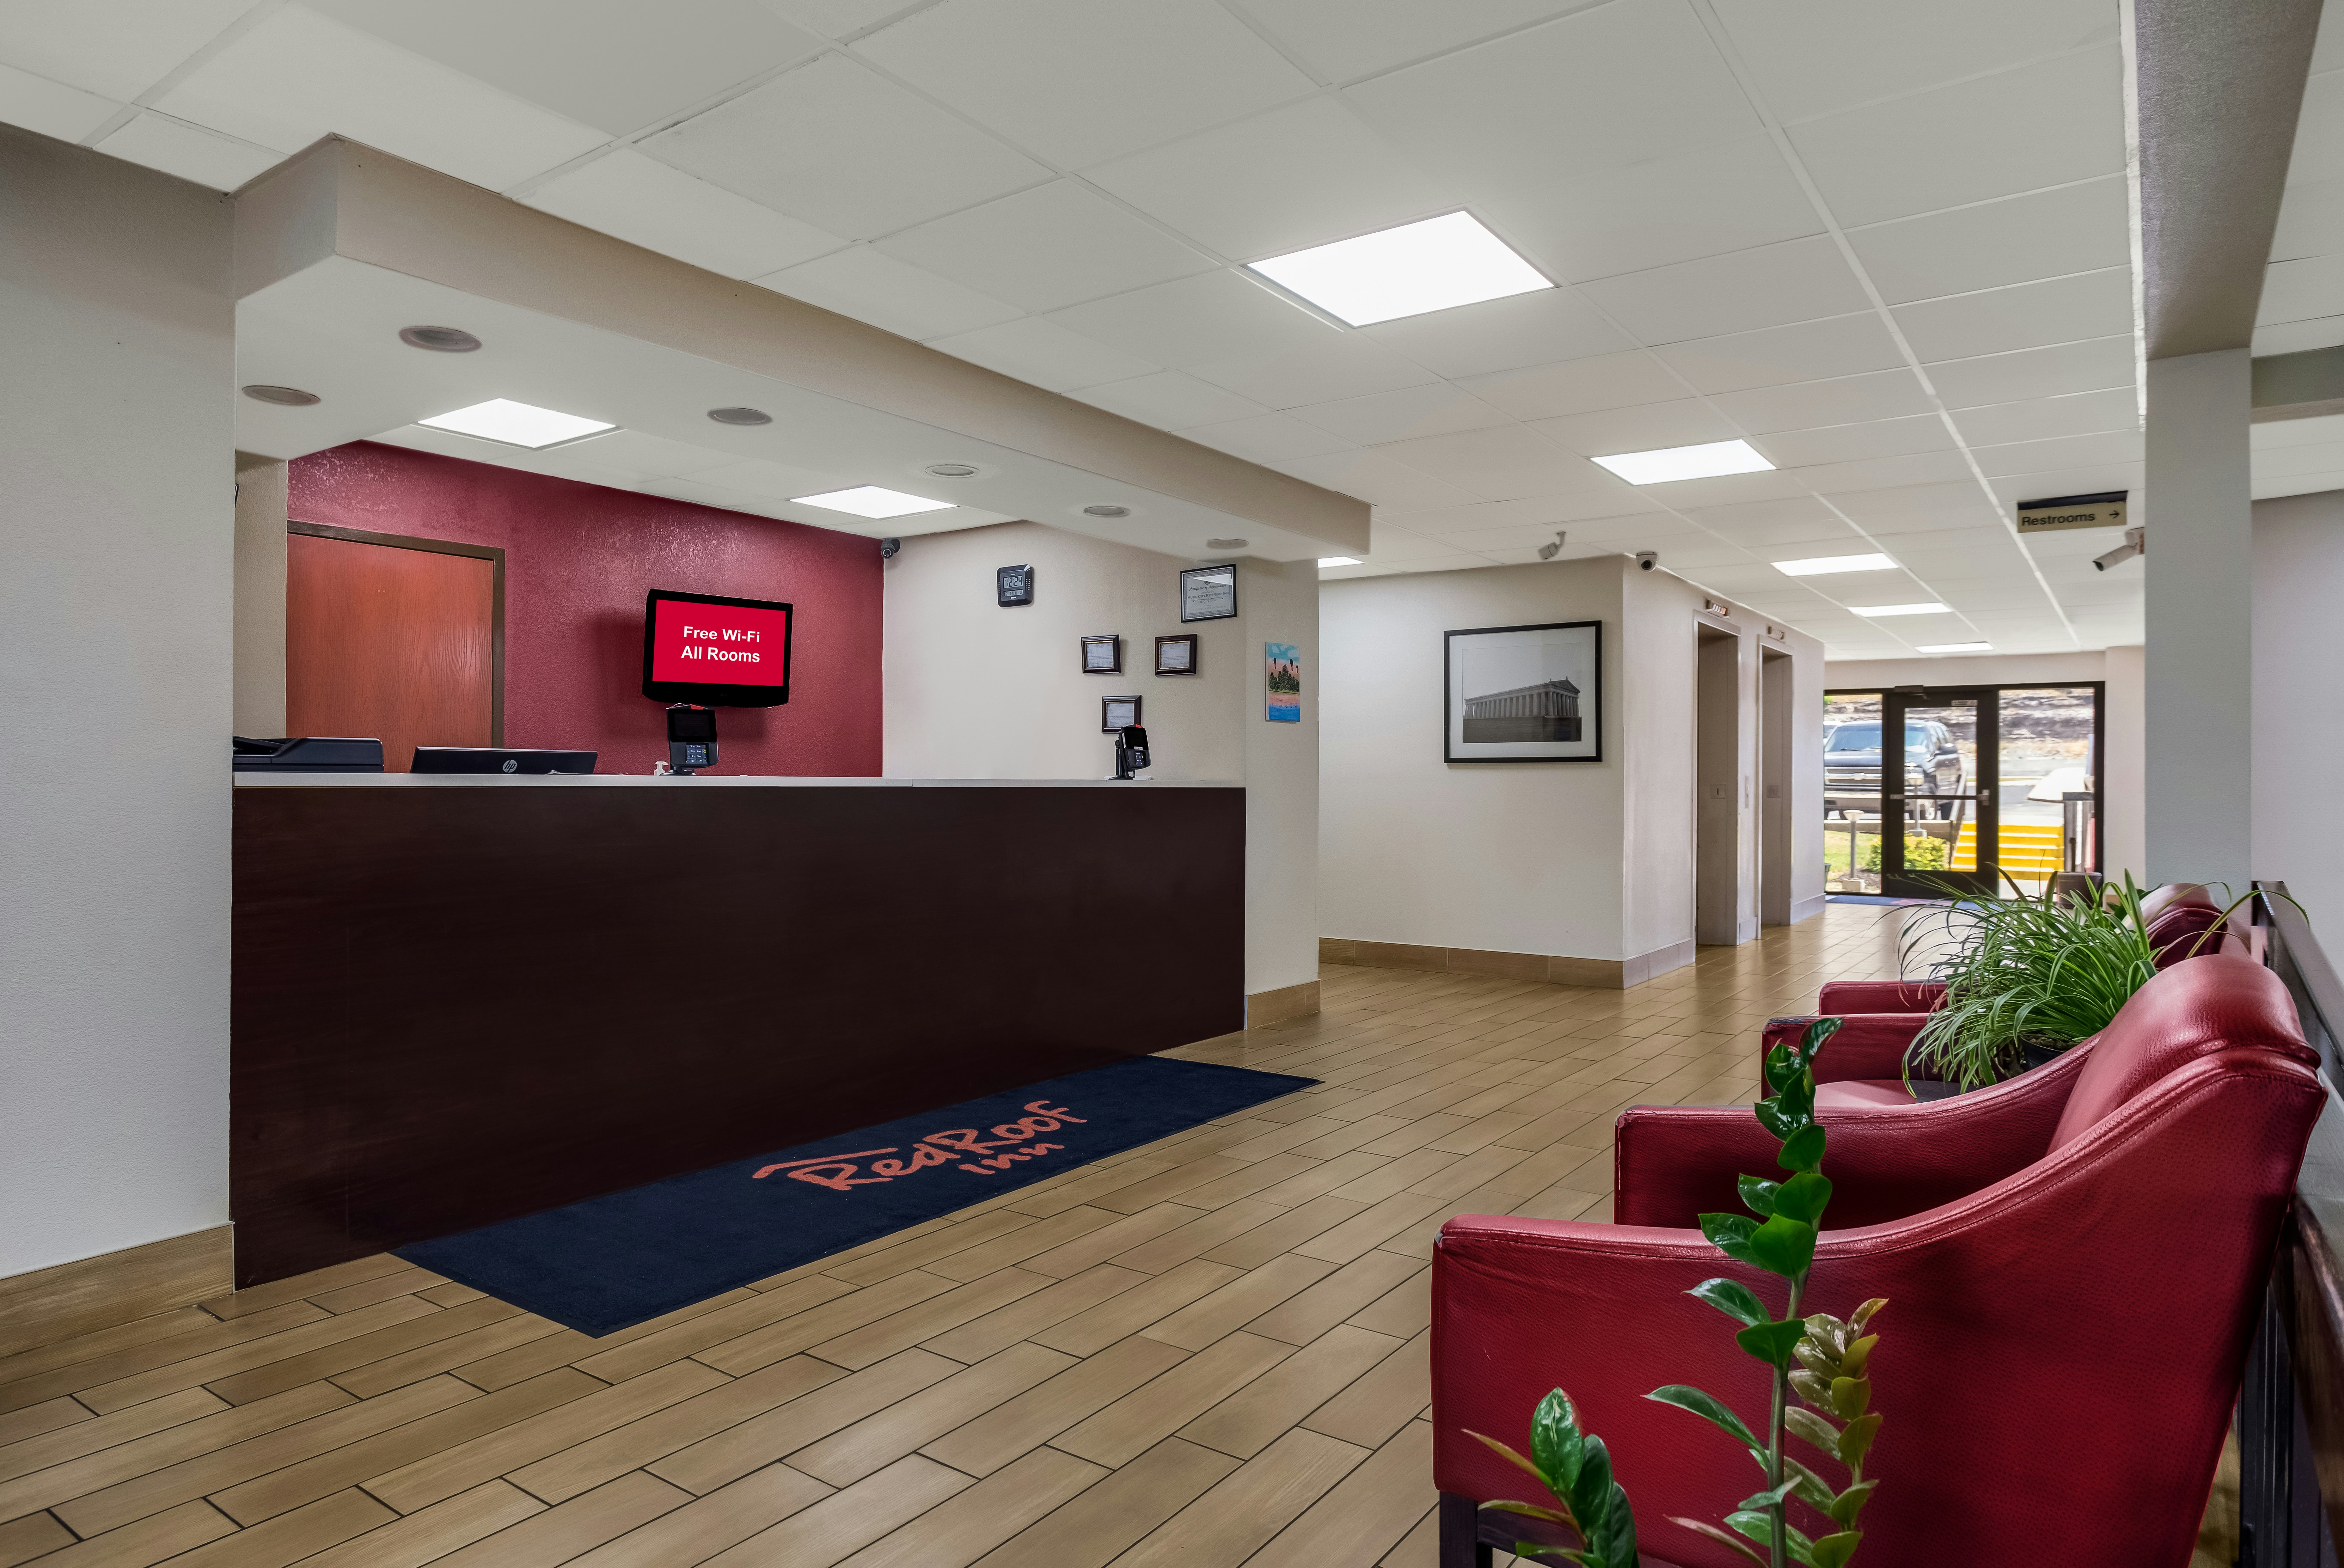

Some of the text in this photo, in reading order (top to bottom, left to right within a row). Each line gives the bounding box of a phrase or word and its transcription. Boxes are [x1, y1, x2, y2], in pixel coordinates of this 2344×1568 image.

[2021, 513, 2095, 526] Restrooms
[1007, 576, 1022, 587] 12:24
[684, 626, 760, 643] Free Wi-Fi
[681, 645, 760, 663] All Rooms
[504, 760, 517, 773] hp
